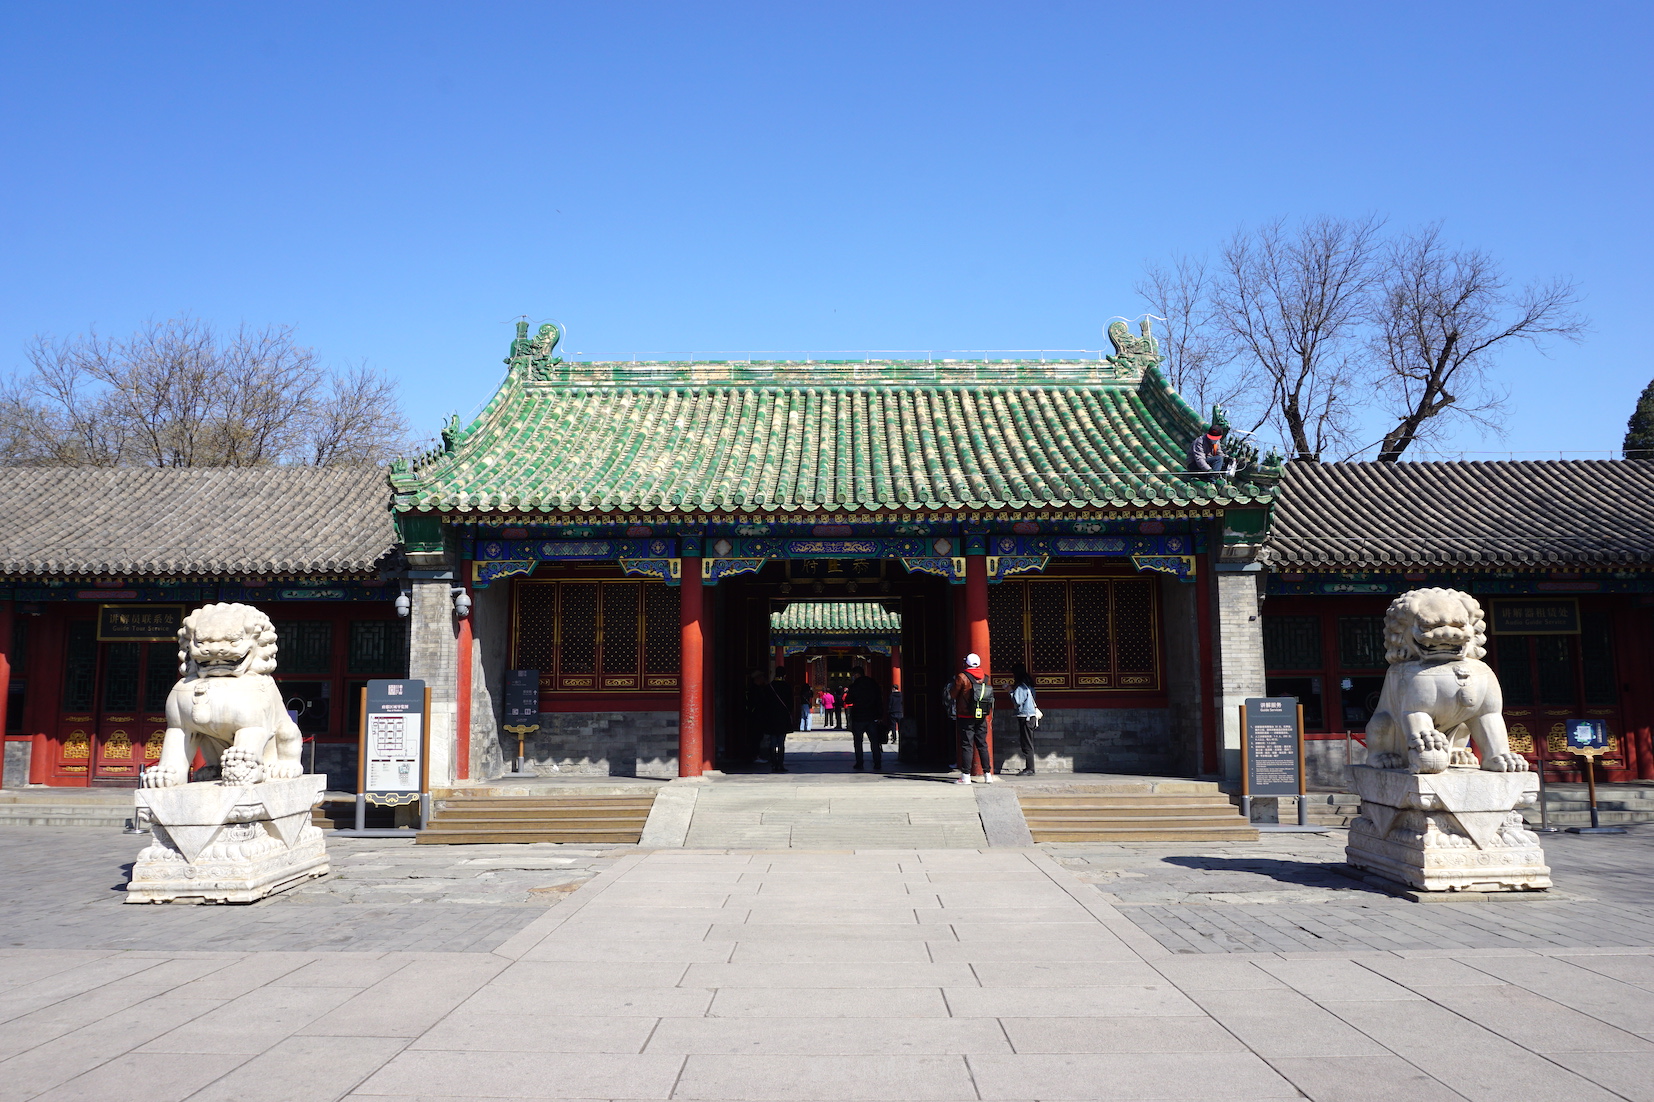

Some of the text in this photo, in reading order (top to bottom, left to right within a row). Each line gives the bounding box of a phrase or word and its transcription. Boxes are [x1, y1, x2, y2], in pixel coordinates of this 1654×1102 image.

[109, 613, 174, 624] 讲解员联系处
